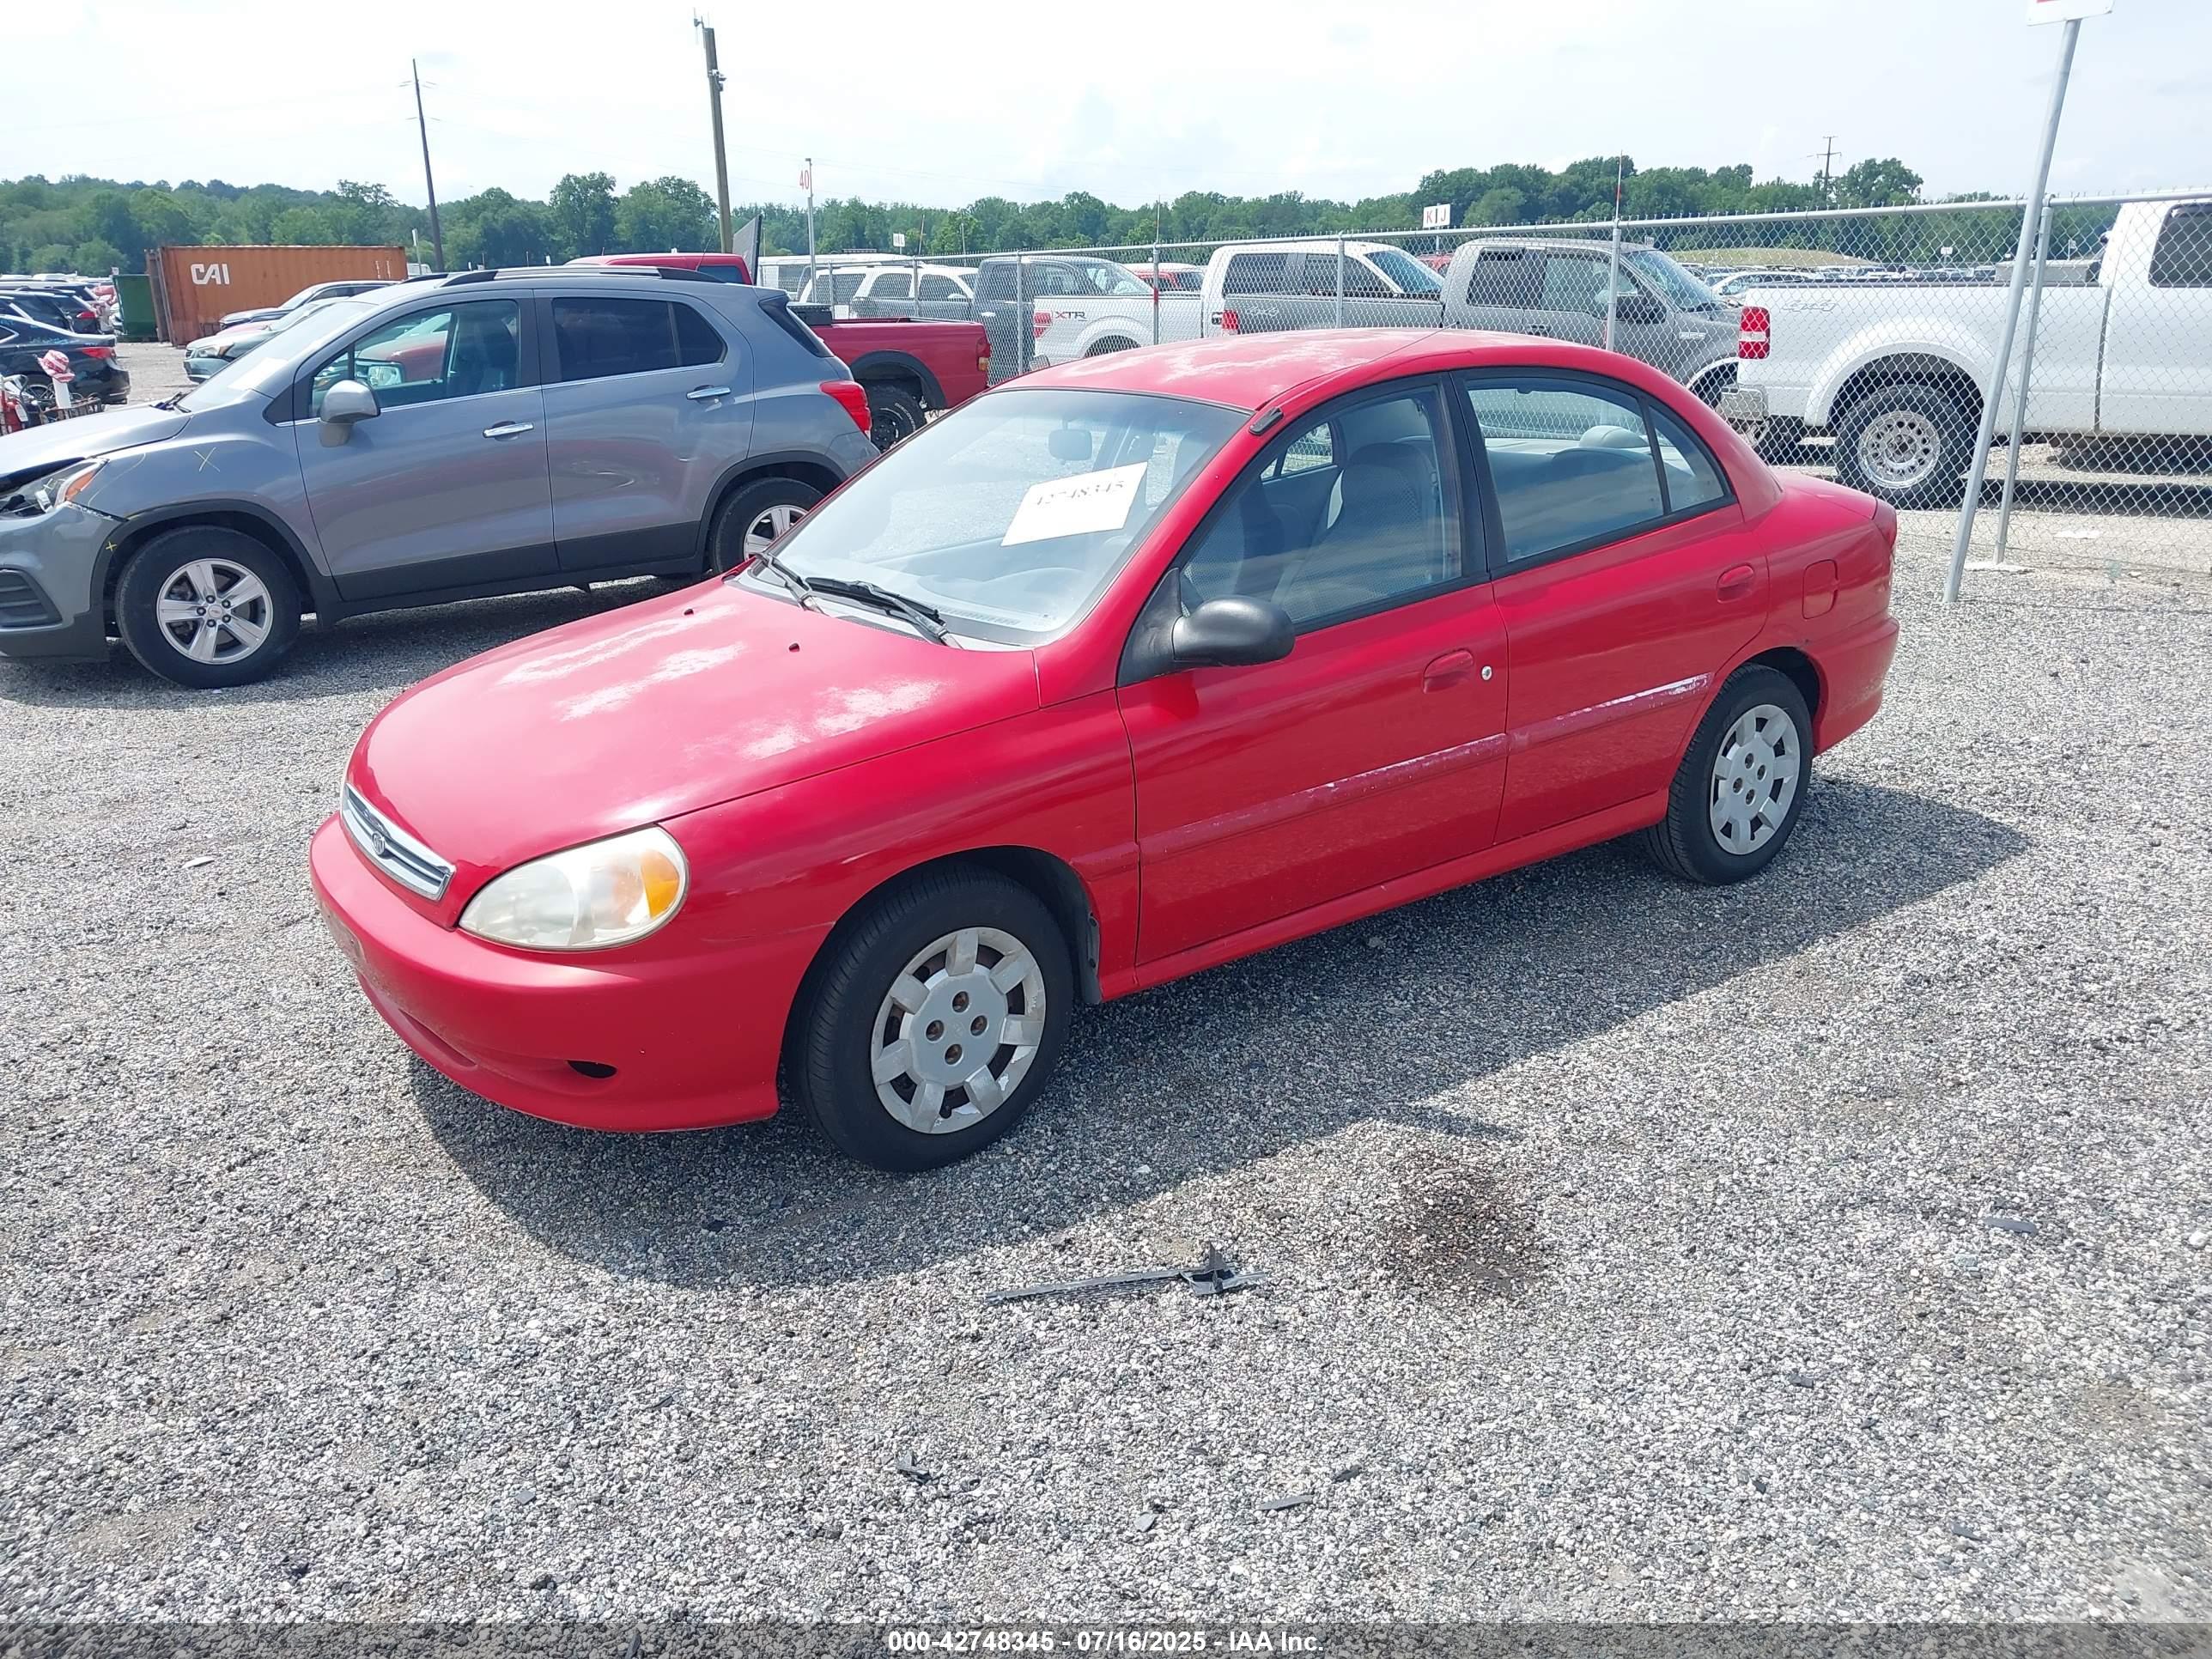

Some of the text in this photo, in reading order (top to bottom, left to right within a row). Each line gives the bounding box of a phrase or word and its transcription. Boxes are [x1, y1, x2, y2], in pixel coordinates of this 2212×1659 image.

[799, 170, 810, 190] 40
[191, 264, 230, 285] CAI
[1055, 311, 1087, 321] XTR
